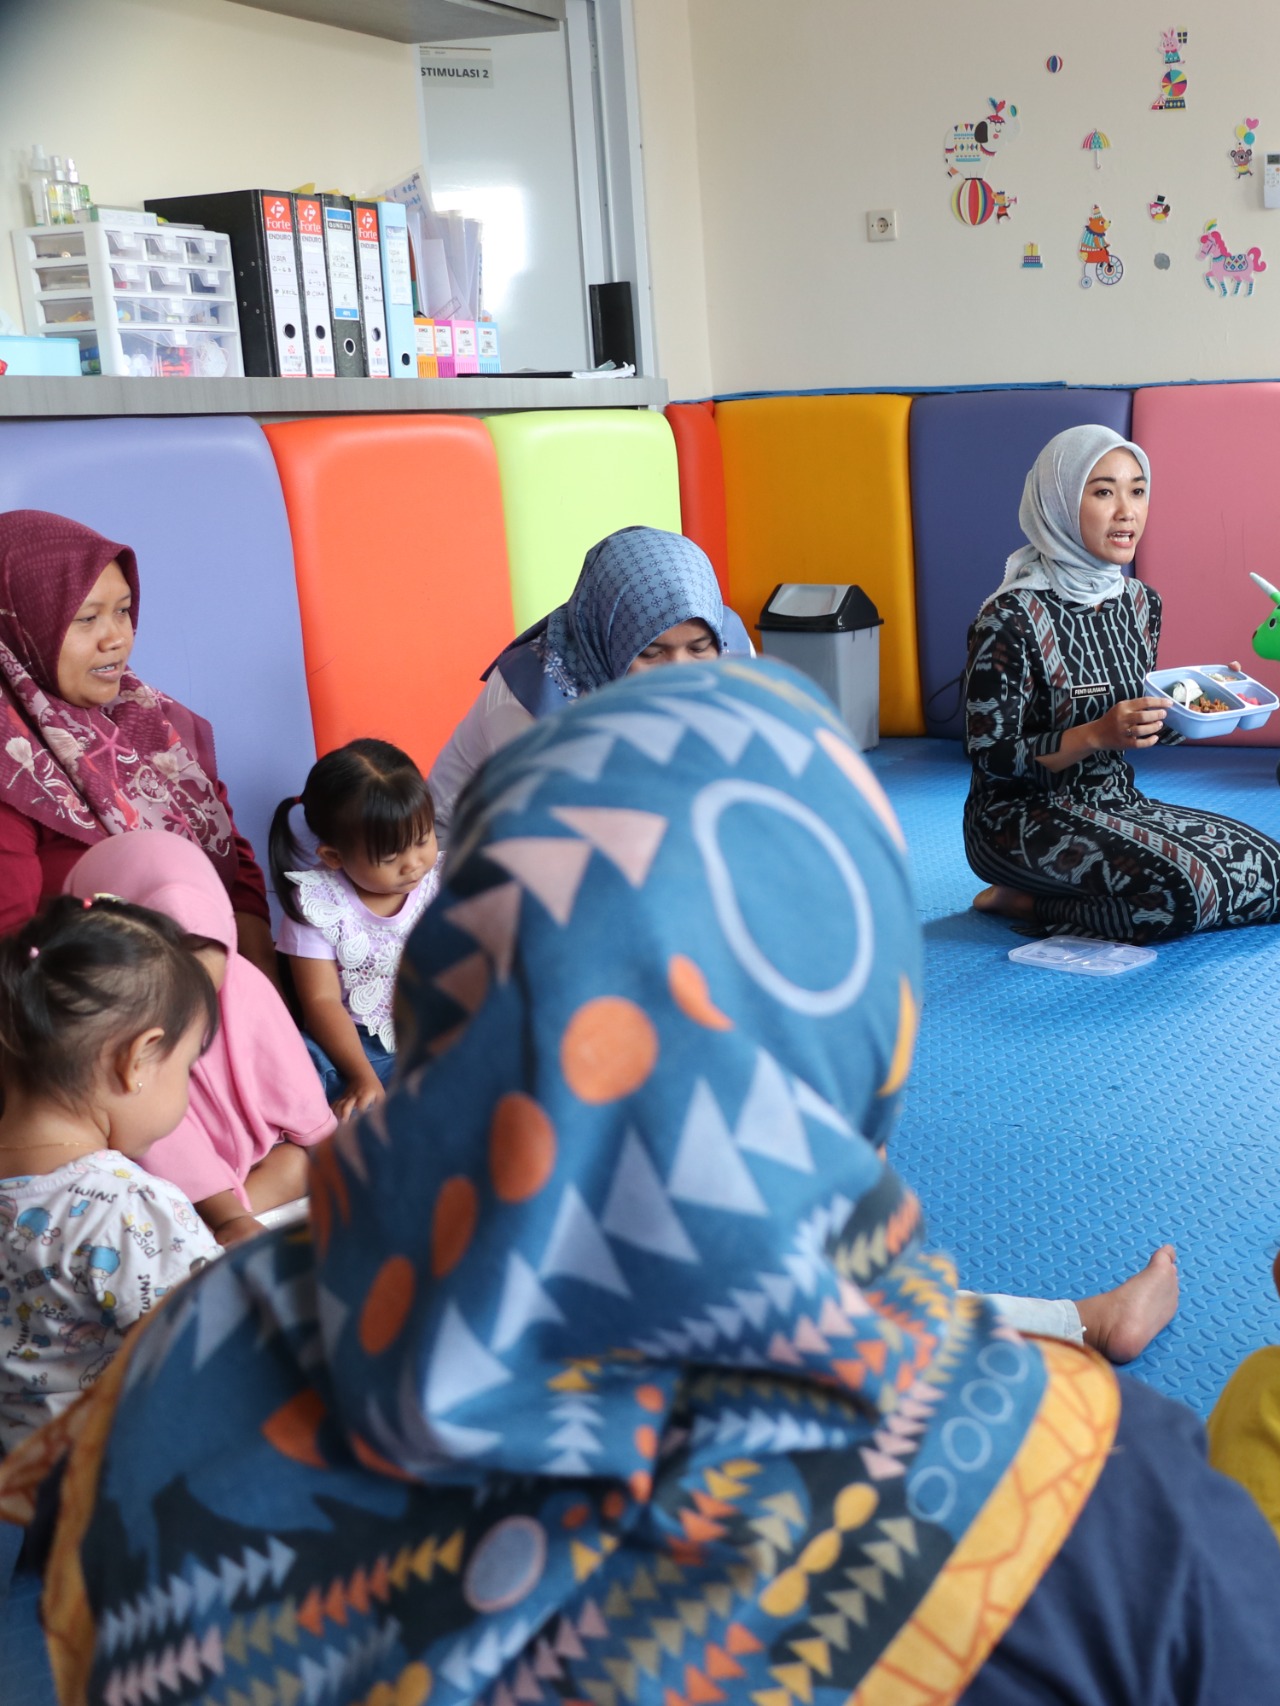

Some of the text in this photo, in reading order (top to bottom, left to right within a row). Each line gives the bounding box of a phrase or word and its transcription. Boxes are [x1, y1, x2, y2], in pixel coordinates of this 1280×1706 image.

[420, 67, 489, 79] STIMULASI 2
[266, 216, 291, 230] Forte
[299, 220, 321, 233] Forte
[268, 233, 292, 241] ENDURO
[301, 235, 322, 243] ENDURO
[359, 227, 378, 240] Forte
[67, 1183, 119, 1203] TWINS
